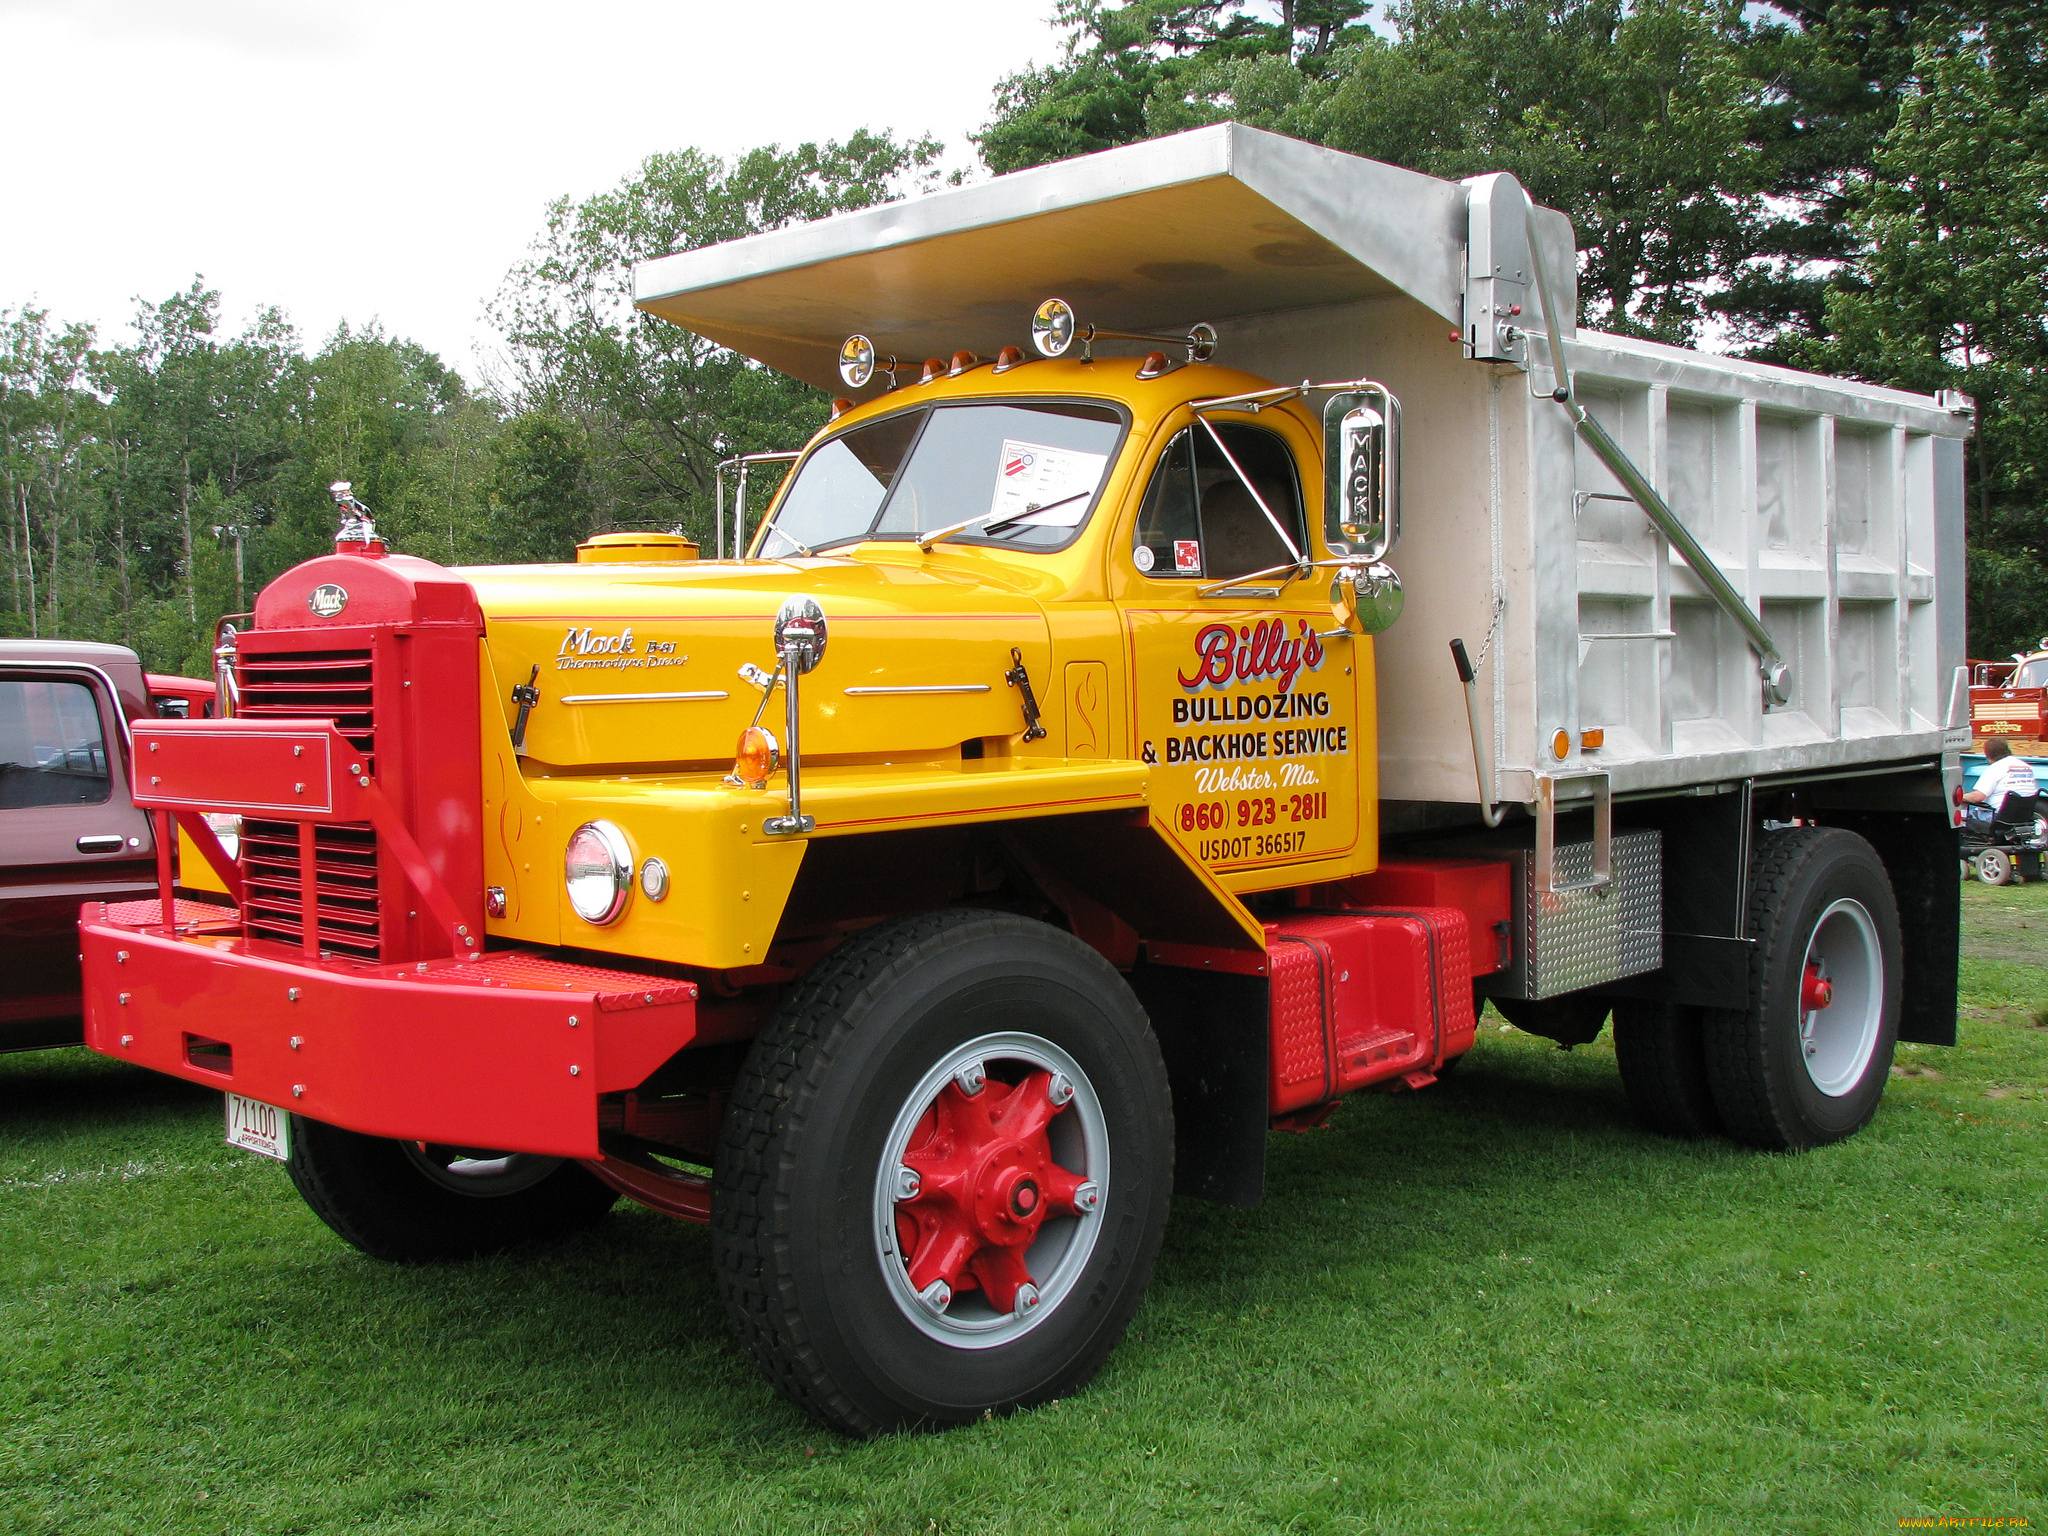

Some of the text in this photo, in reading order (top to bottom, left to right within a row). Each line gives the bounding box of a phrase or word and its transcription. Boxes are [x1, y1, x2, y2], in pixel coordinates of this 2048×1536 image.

[1351, 433, 1370, 515] MACK
[312, 588, 342, 613] Mack
[556, 627, 637, 656] Mack
[1177, 617, 1326, 693] Billy's
[555, 654, 689, 672] Thermodyne Diesel
[1172, 691, 1331, 726] BULLDOZING
[1141, 726, 1348, 766] & BACKHOE SERVICE
[1194, 762, 1320, 794] Webster, Ma.
[1173, 799, 1231, 834] (860)
[1200, 831, 1306, 862] USDOT 366517
[233, 1096, 276, 1140] 71100
